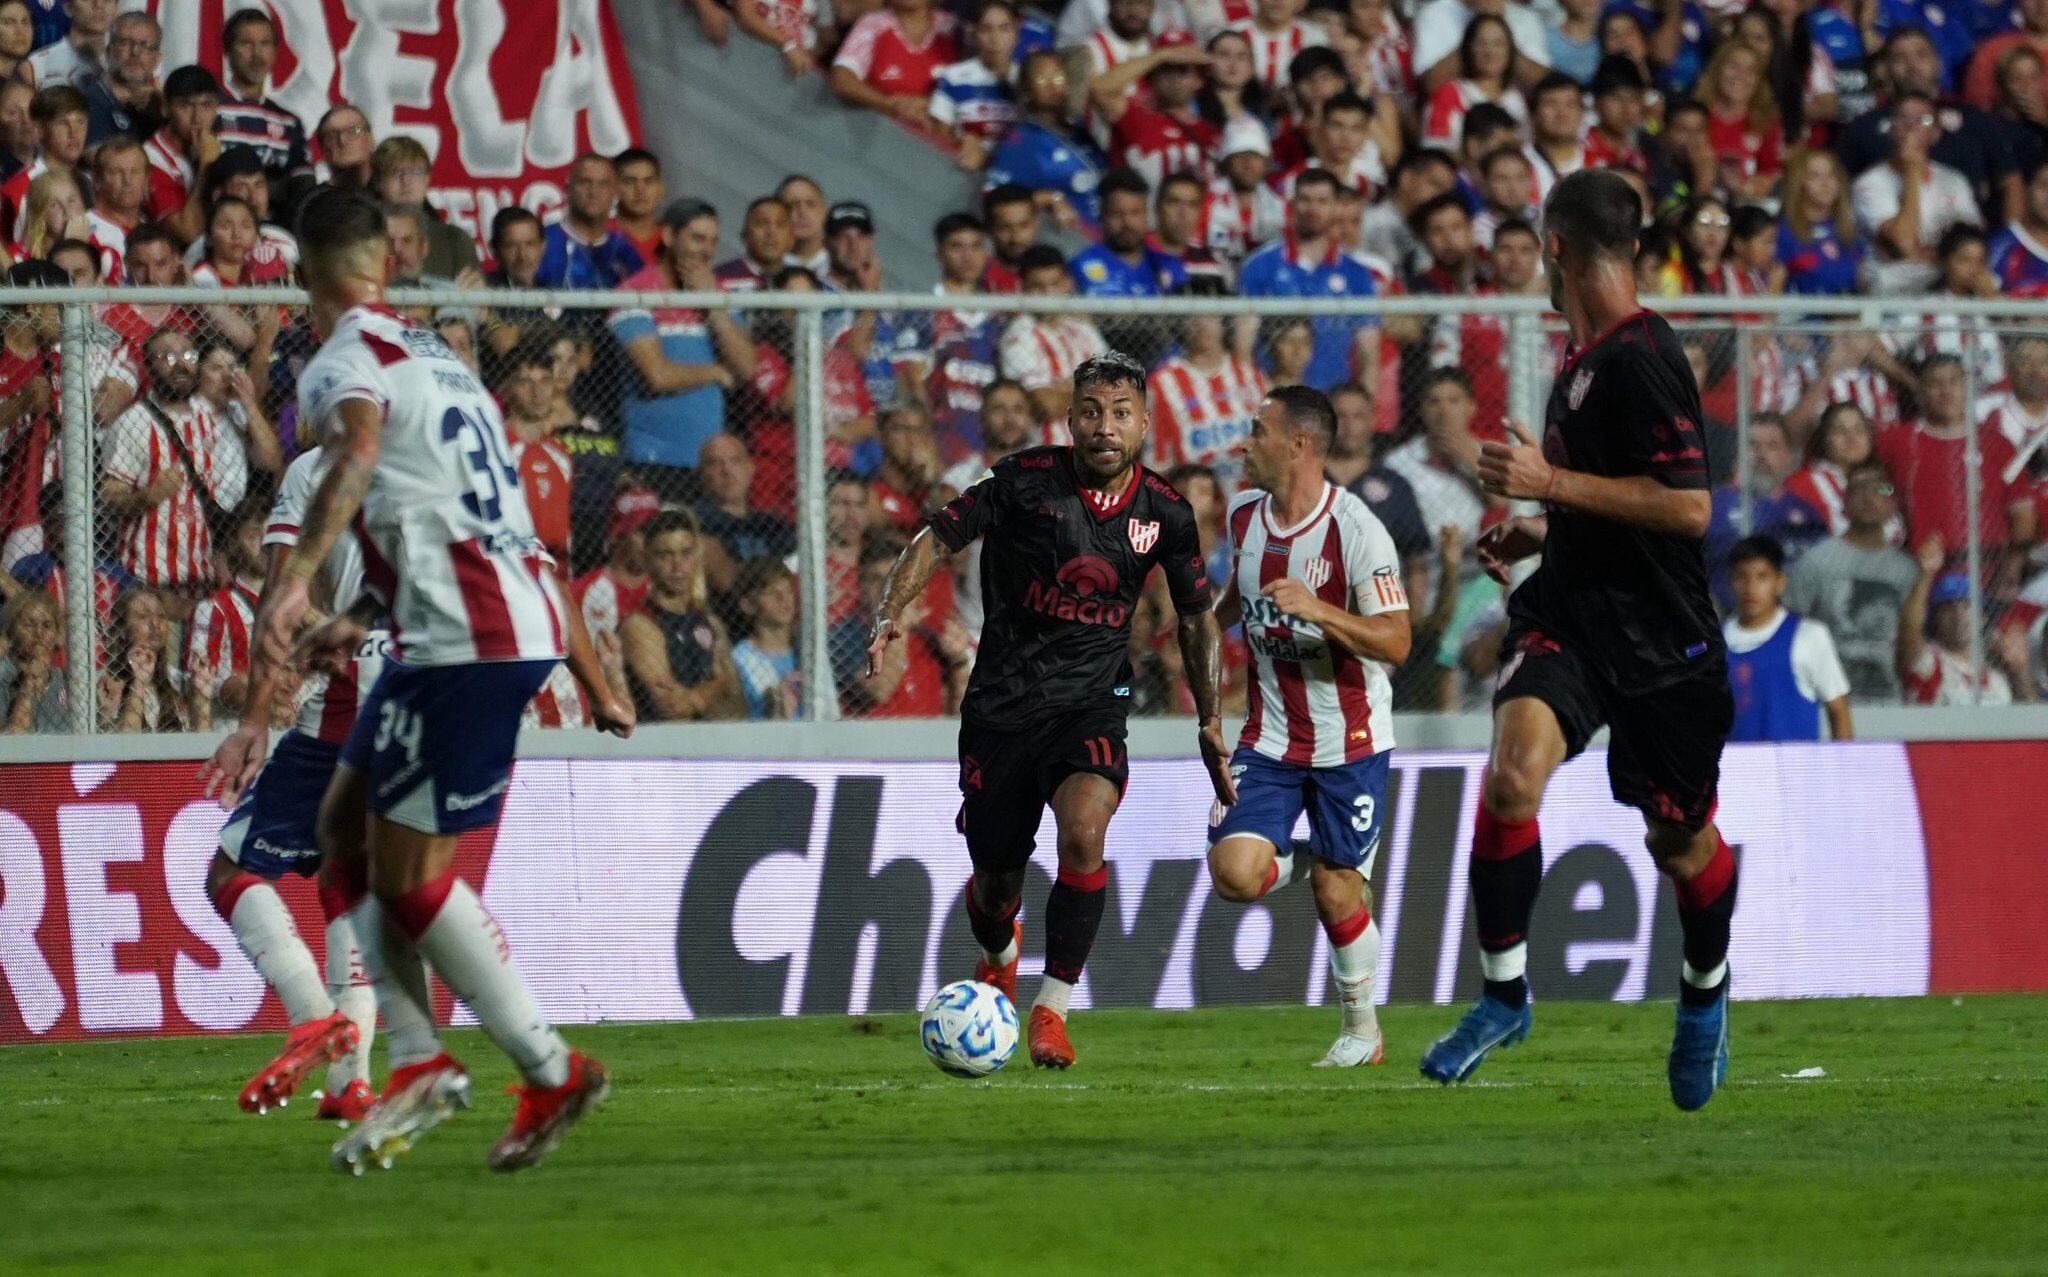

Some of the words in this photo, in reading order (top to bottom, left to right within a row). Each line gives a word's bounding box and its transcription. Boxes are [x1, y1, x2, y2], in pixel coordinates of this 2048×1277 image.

[441, 406, 518, 522] 34
[1145, 475, 1181, 502] Befol
[1022, 579, 1127, 629] Macro
[1249, 633, 1326, 661] Vidalac
[373, 699, 423, 763] 34
[1084, 736, 1113, 767] 11
[1351, 794, 1375, 832] 3
